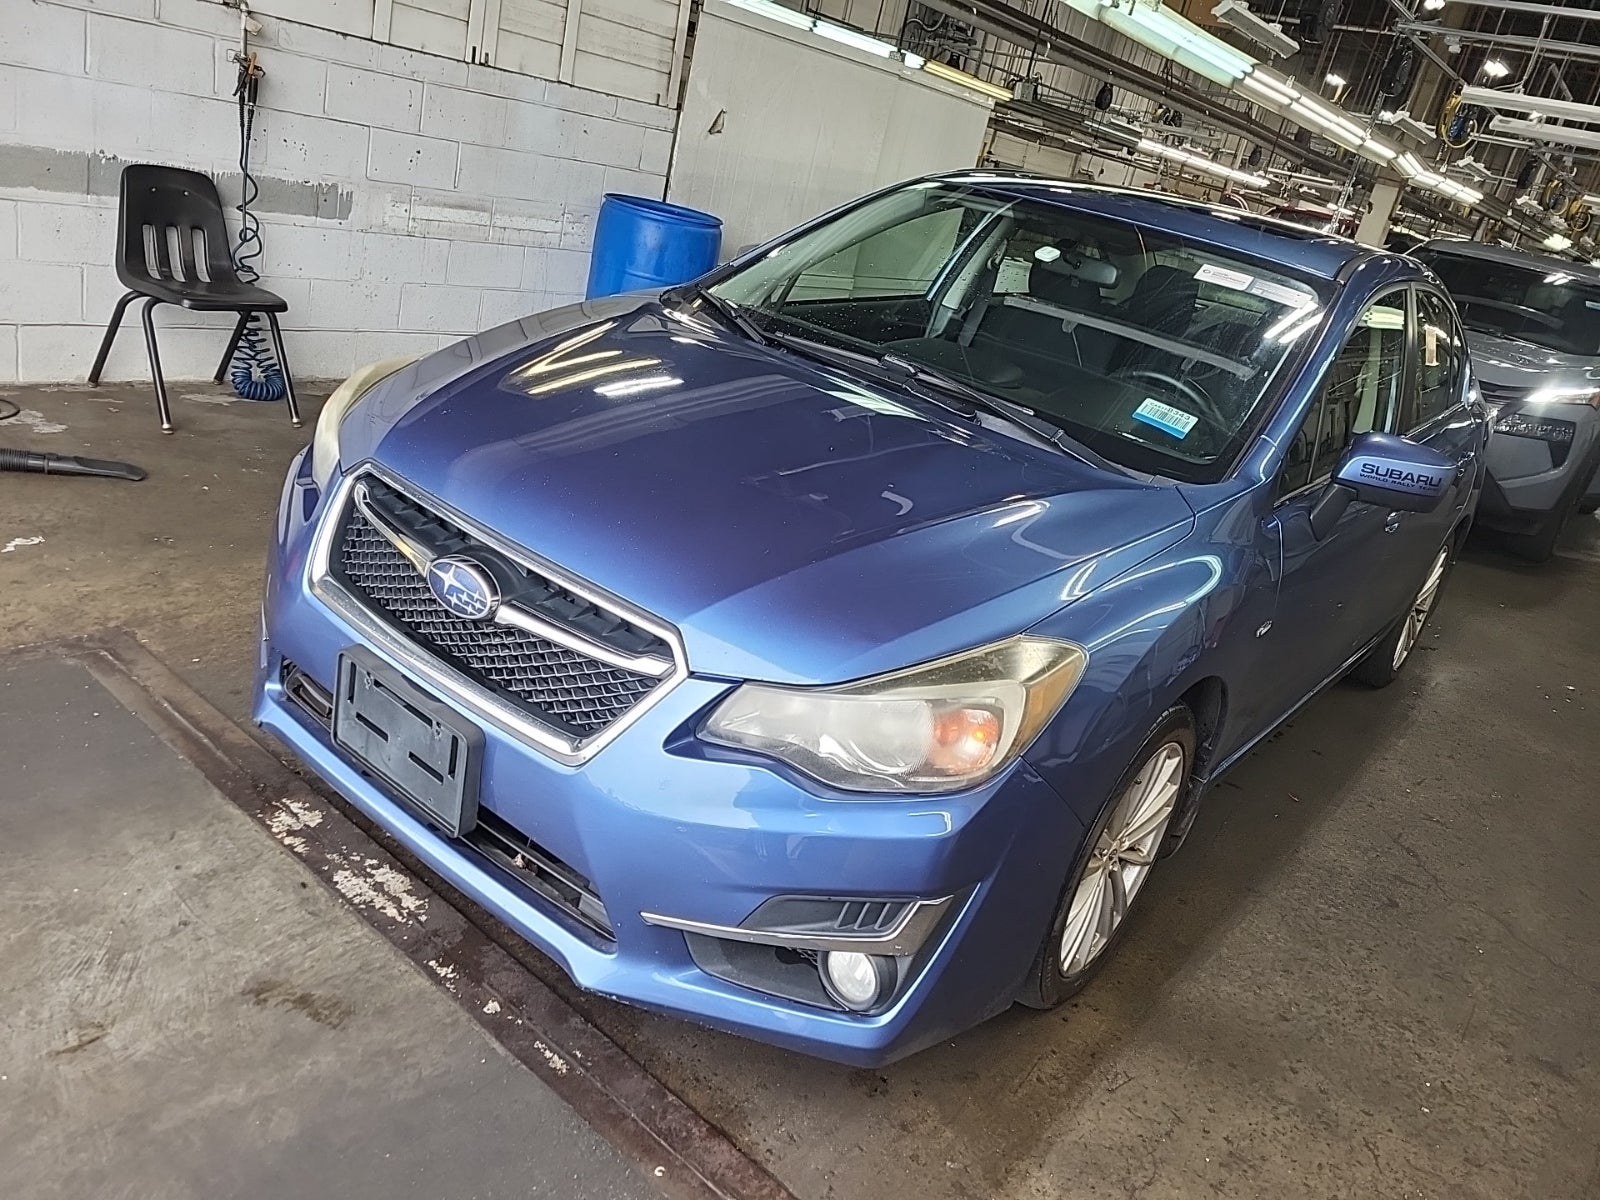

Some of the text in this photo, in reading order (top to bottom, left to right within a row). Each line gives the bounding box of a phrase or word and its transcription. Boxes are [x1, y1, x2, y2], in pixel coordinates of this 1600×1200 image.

[1360, 473, 1388, 483] WORLD
[1391, 480, 1416, 488] RALLY
[1361, 463, 1442, 487] SUBARU
